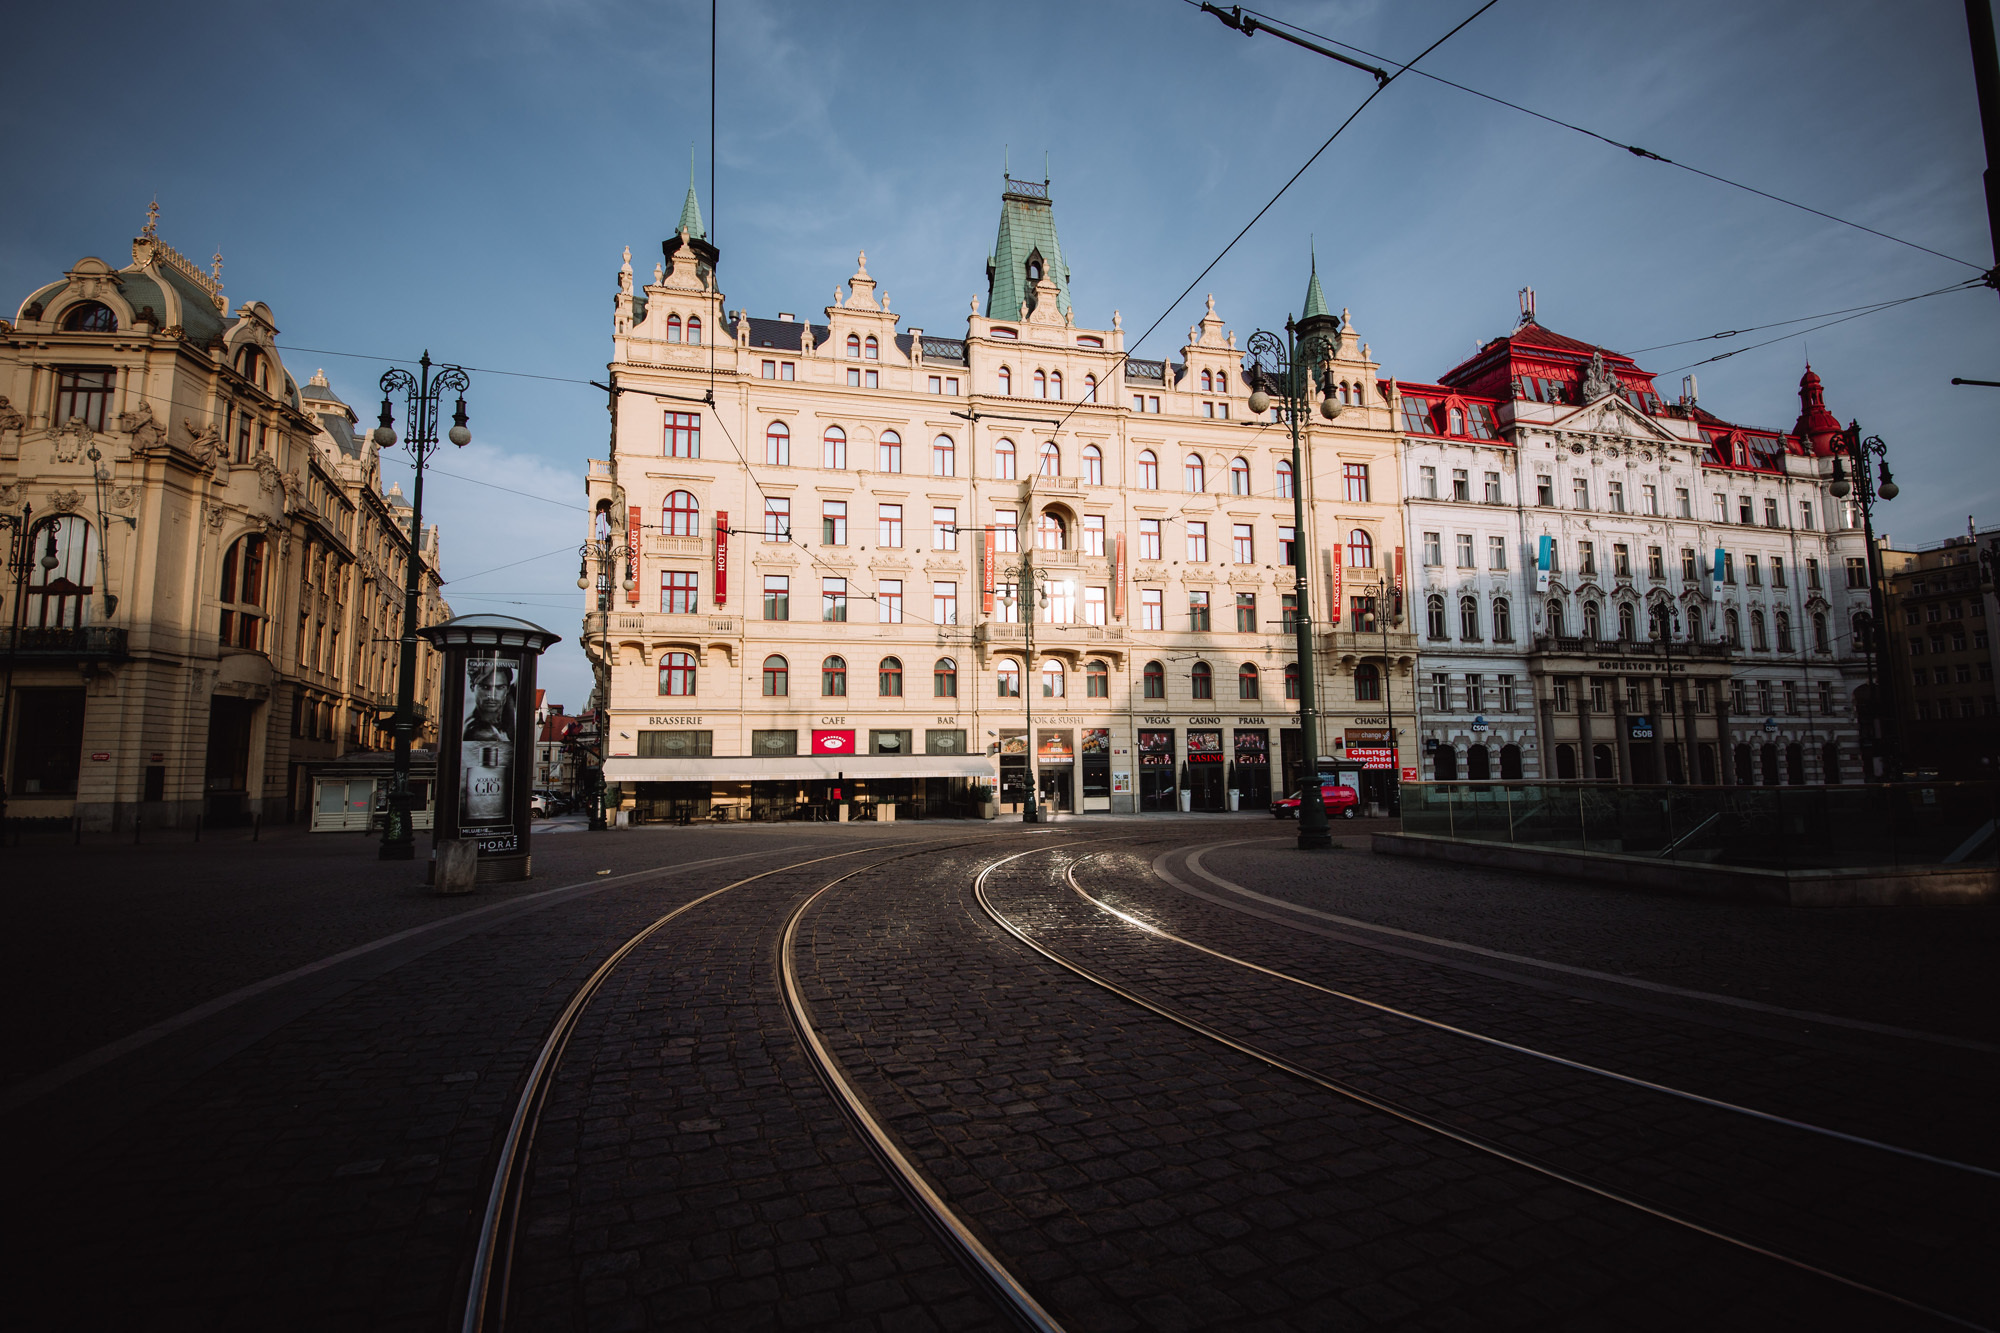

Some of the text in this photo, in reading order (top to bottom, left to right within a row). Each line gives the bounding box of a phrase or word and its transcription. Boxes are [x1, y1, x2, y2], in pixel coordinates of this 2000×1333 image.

[717, 542, 726, 571] HOTEL
[1598, 661, 1651, 671] KONEKTOR
[648, 716, 703, 725] BRASSERIE
[821, 716, 846, 725] CAFE
[937, 716, 955, 725] BAR
[1049, 716, 1056, 724] &
[1058, 716, 1084, 724] SUSHI
[1144, 716, 1171, 725] VEGAS
[1189, 716, 1221, 725] CASINO
[1238, 717, 1265, 725] PRAHA
[1354, 717, 1388, 725] CHANGE
[1361, 731, 1382, 739] change
[1632, 729, 1653, 738] ČSOB
[1351, 748, 1392, 756] change
[1188, 754, 1224, 762] CASINO
[478, 840, 511, 850] HORA
